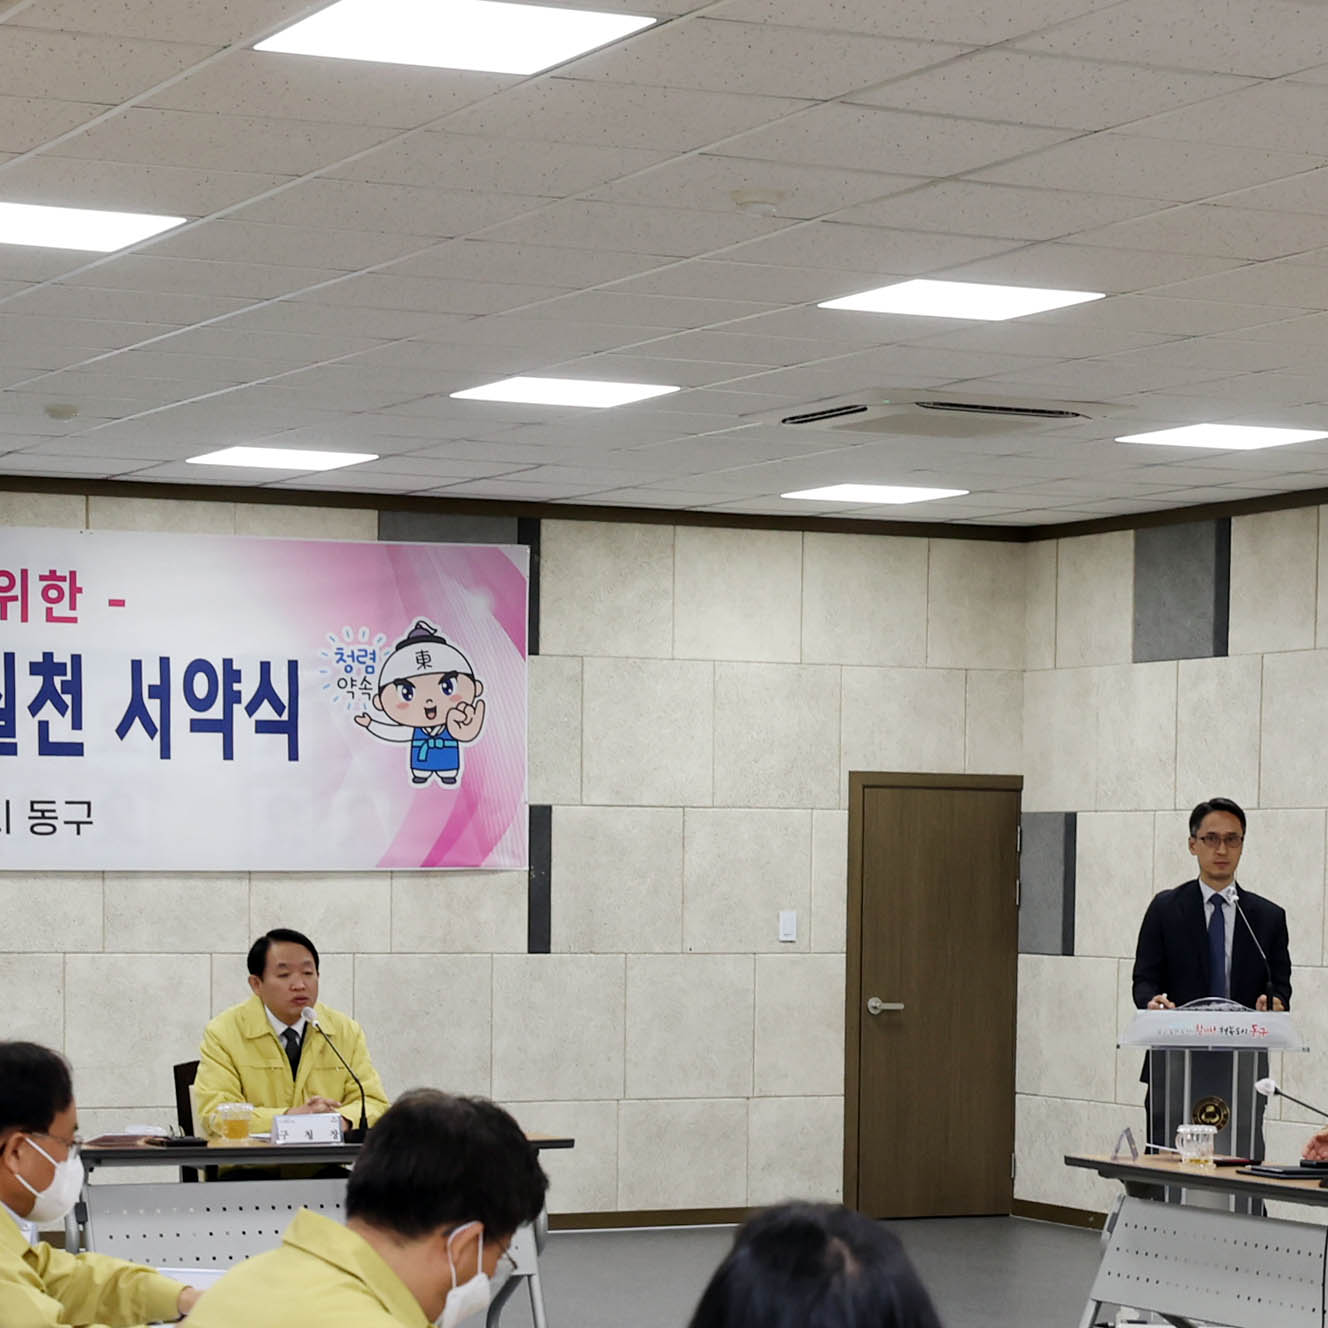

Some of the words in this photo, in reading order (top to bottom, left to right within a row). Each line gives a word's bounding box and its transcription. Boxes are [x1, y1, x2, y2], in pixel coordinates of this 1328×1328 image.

[334, 647, 377, 675] 청렴
[415, 650, 433, 670] 東
[336, 675, 373, 701] 약속
[114, 656, 300, 762] 서약식
[27, 799, 94, 836] 동구
